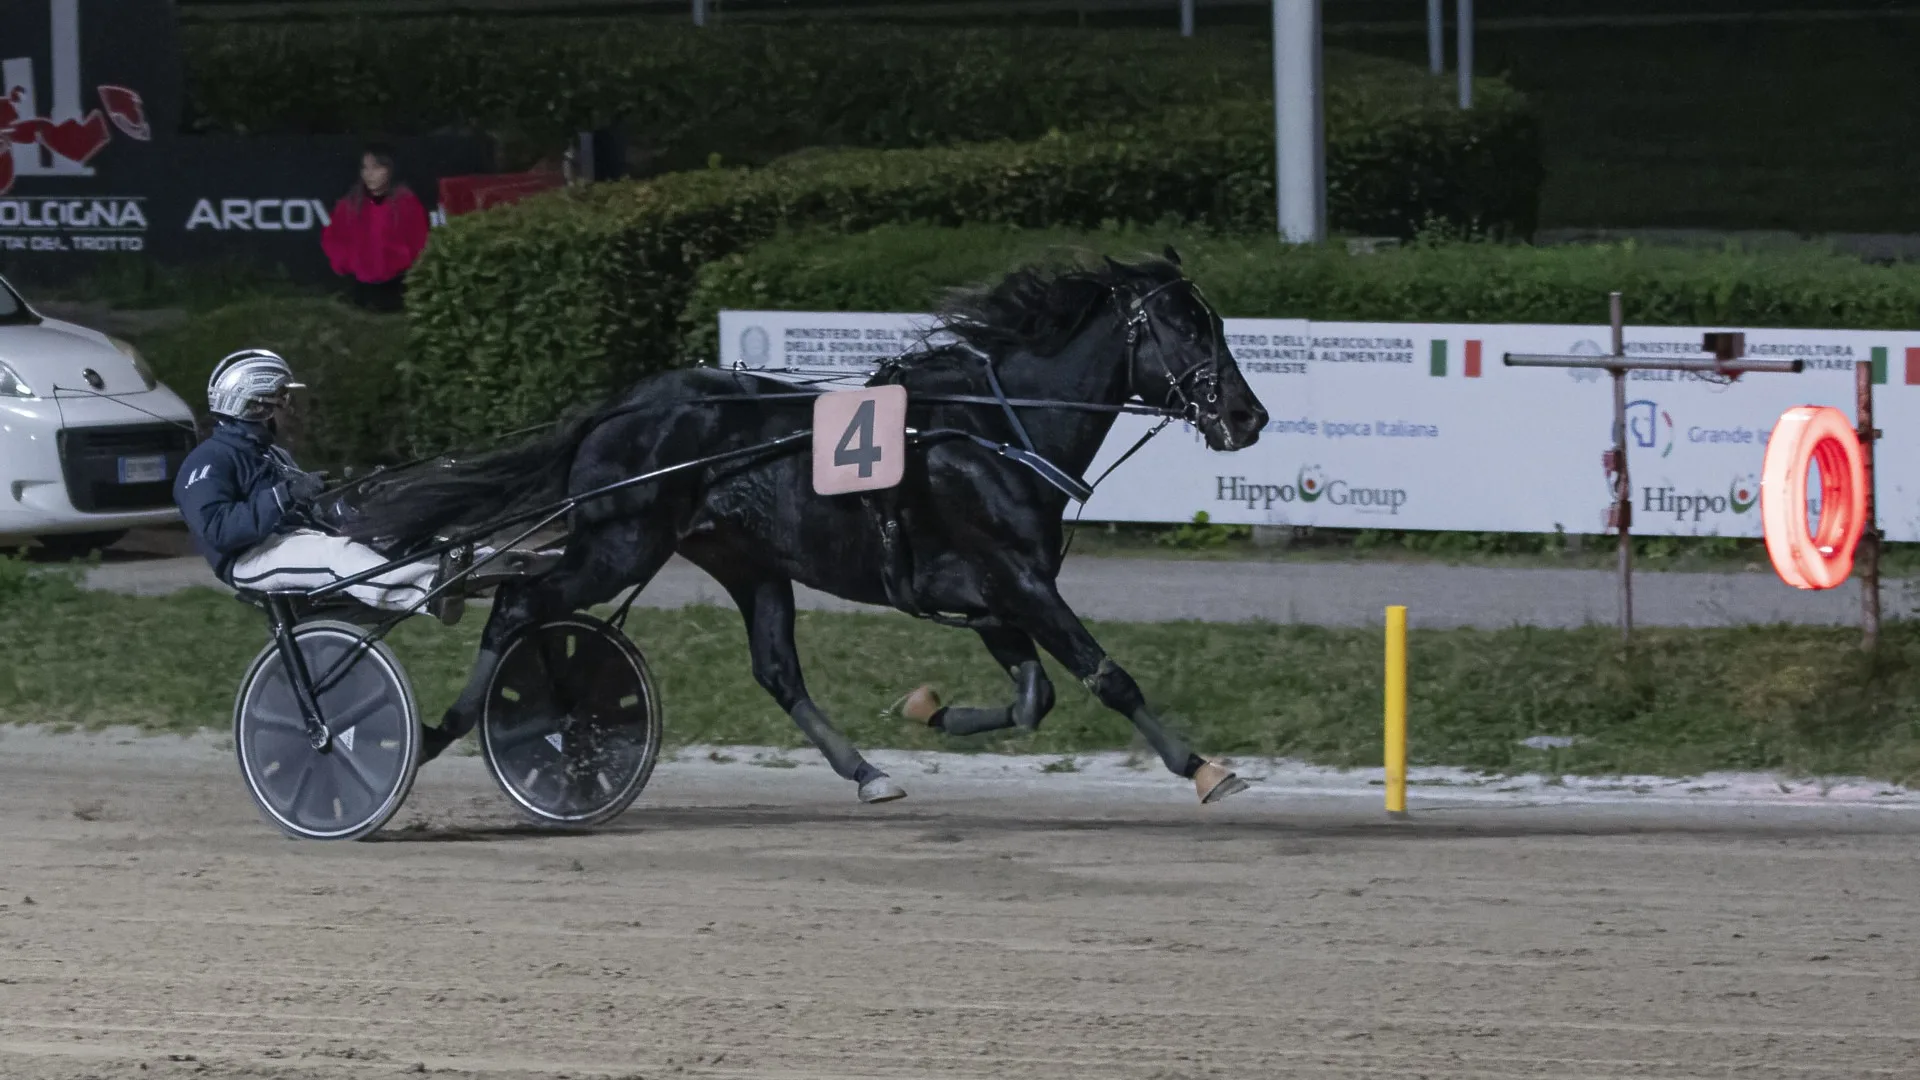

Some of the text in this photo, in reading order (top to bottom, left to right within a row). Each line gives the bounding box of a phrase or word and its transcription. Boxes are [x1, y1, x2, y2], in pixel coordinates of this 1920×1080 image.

[785, 328, 861, 340] MINISTERO
[1320, 351, 1413, 363] ALIMENTARE
[1246, 362, 1307, 373] FORESTE
[1262, 417, 1318, 435] rande
[1376, 420, 1440, 437] Italiana
[1687, 425, 1753, 444] Grande
[834, 400, 881, 478] 4
[1215, 475, 1407, 515] Hippo Group
[1642, 486, 1726, 522] Hippo
